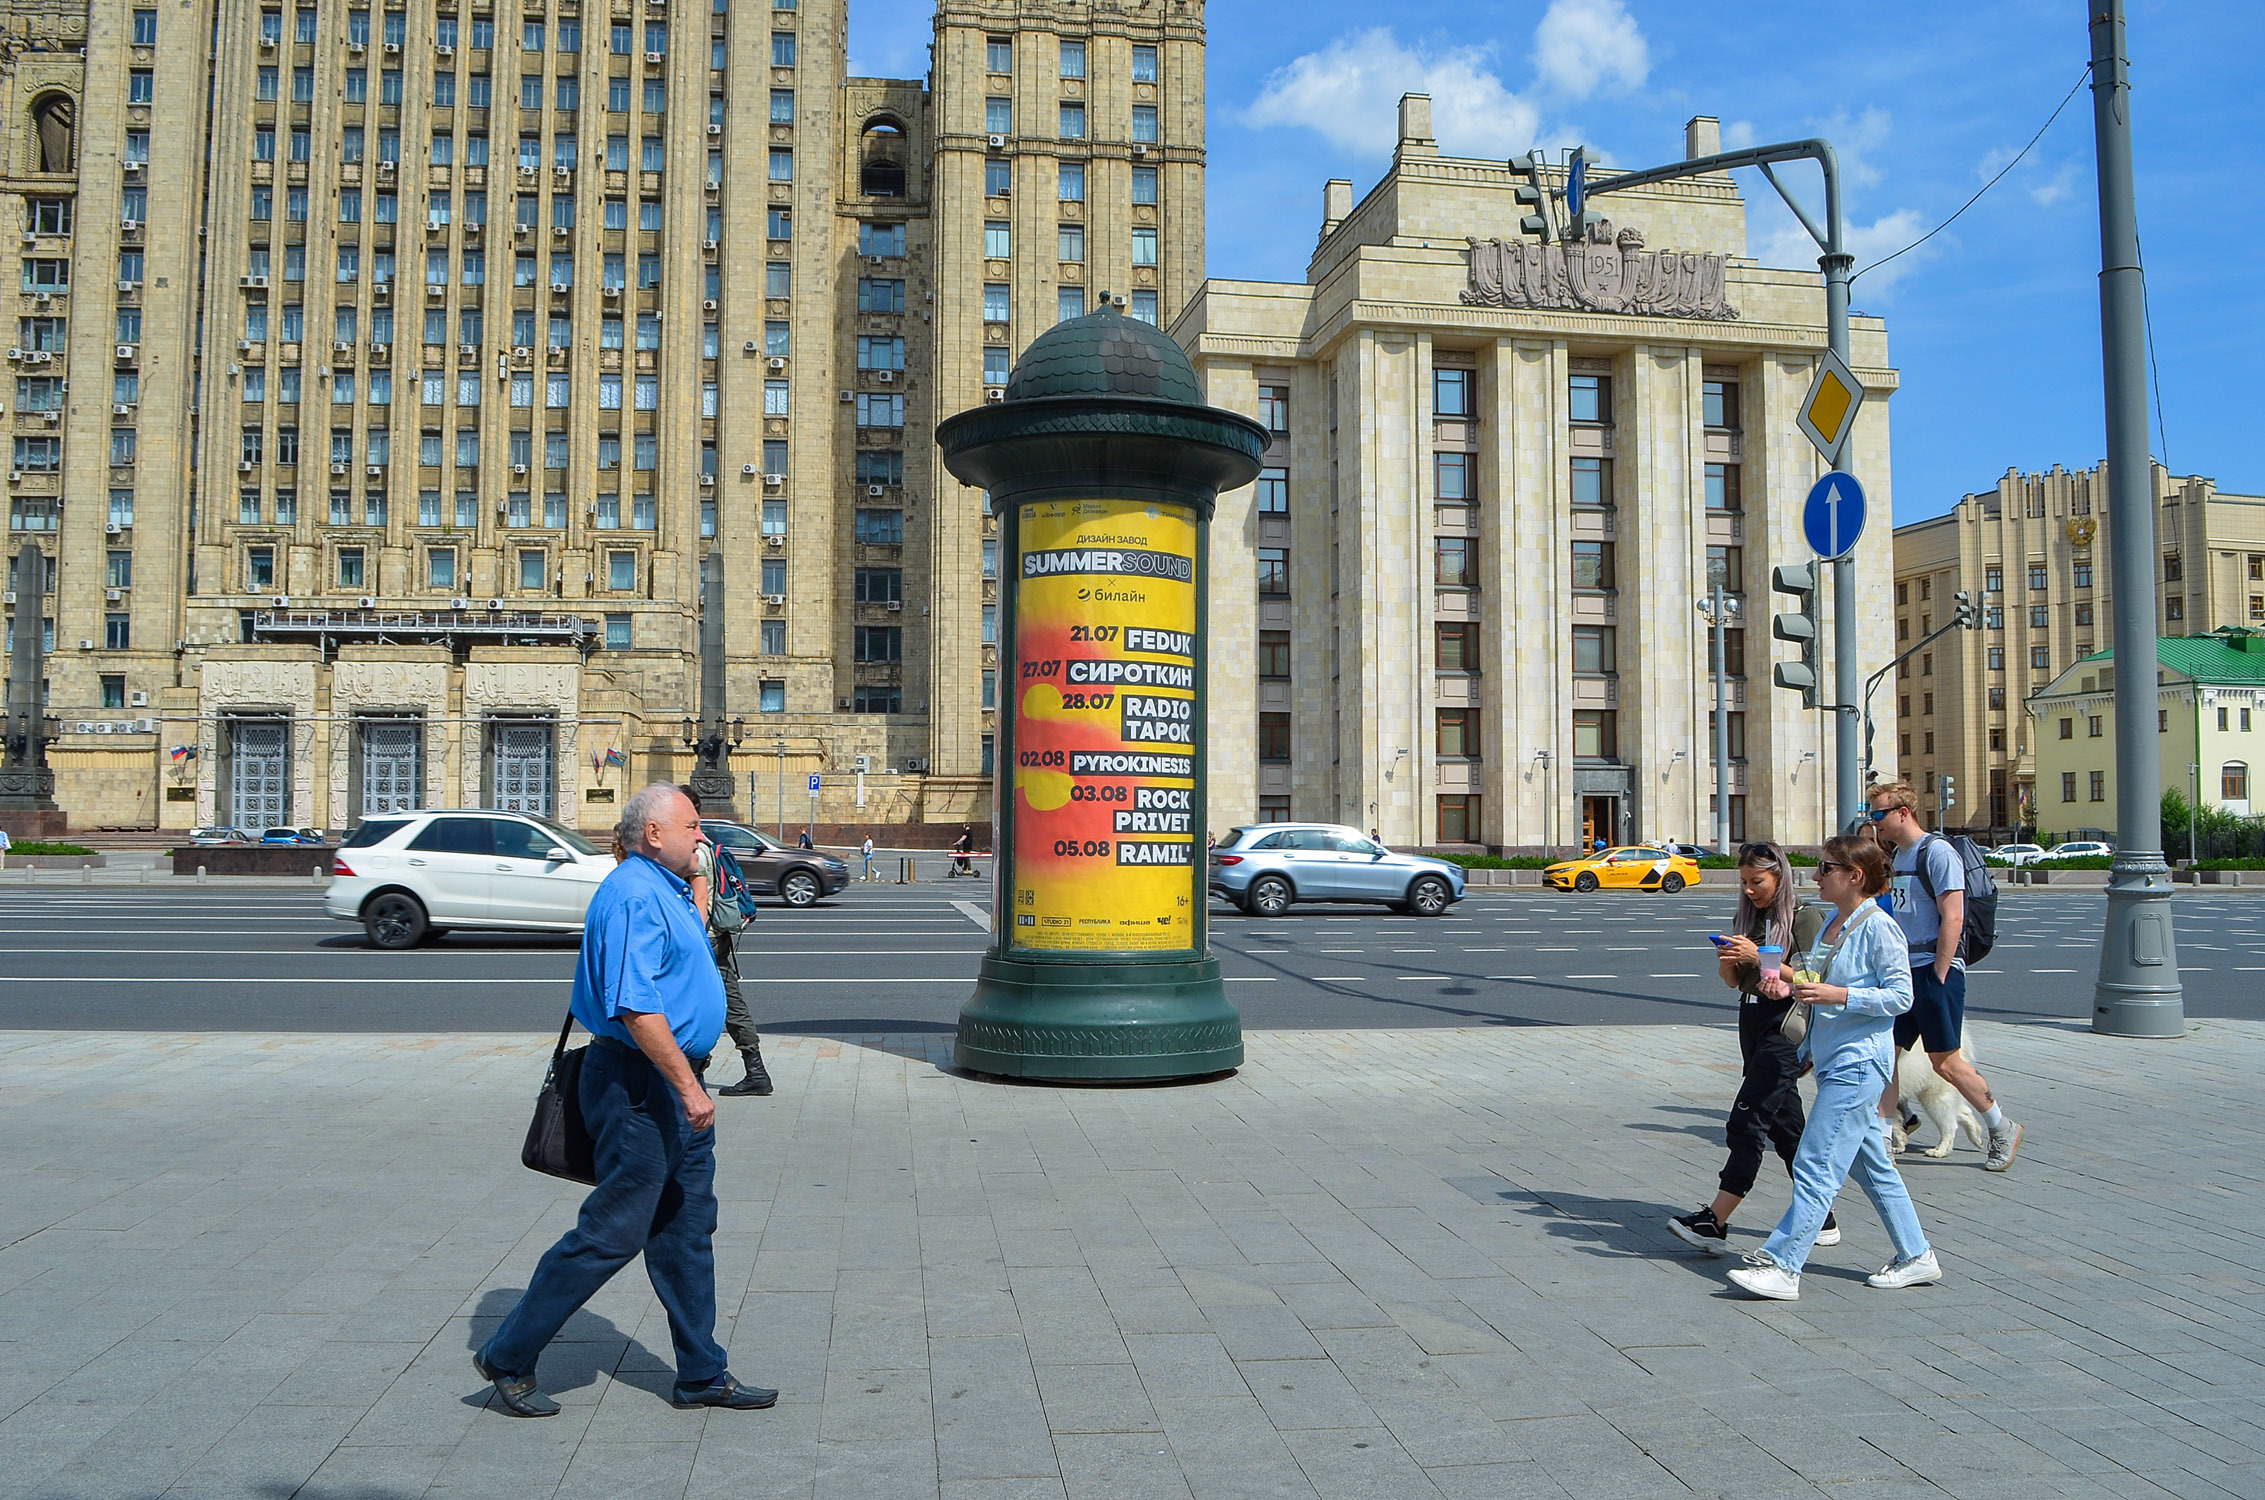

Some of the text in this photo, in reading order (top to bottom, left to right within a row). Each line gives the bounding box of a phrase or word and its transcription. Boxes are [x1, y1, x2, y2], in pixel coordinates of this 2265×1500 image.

[1589, 255, 1618, 277] 1951
[1077, 533, 1148, 546] ДИЗАЙН ЗАВОД
[1094, 588, 1146, 603] билайн
[1070, 625, 1191, 655] 21.07 FEDUK
[1023, 660, 1192, 688] 27.07 СИРОТКИН
[1062, 694, 1190, 719] 28.07 RADIO
[1126, 720, 1190, 743] TAPOK
[1020, 751, 1191, 775] 02.08 PYROKINESIS
[811, 777, 818, 789] P
[1070, 785, 1190, 810] 03.08 ROCK
[1116, 812, 1190, 832] PRIVET
[1054, 840, 1190, 864] 05.08 RAMIL'
[1177, 896, 1189, 907] 16+
